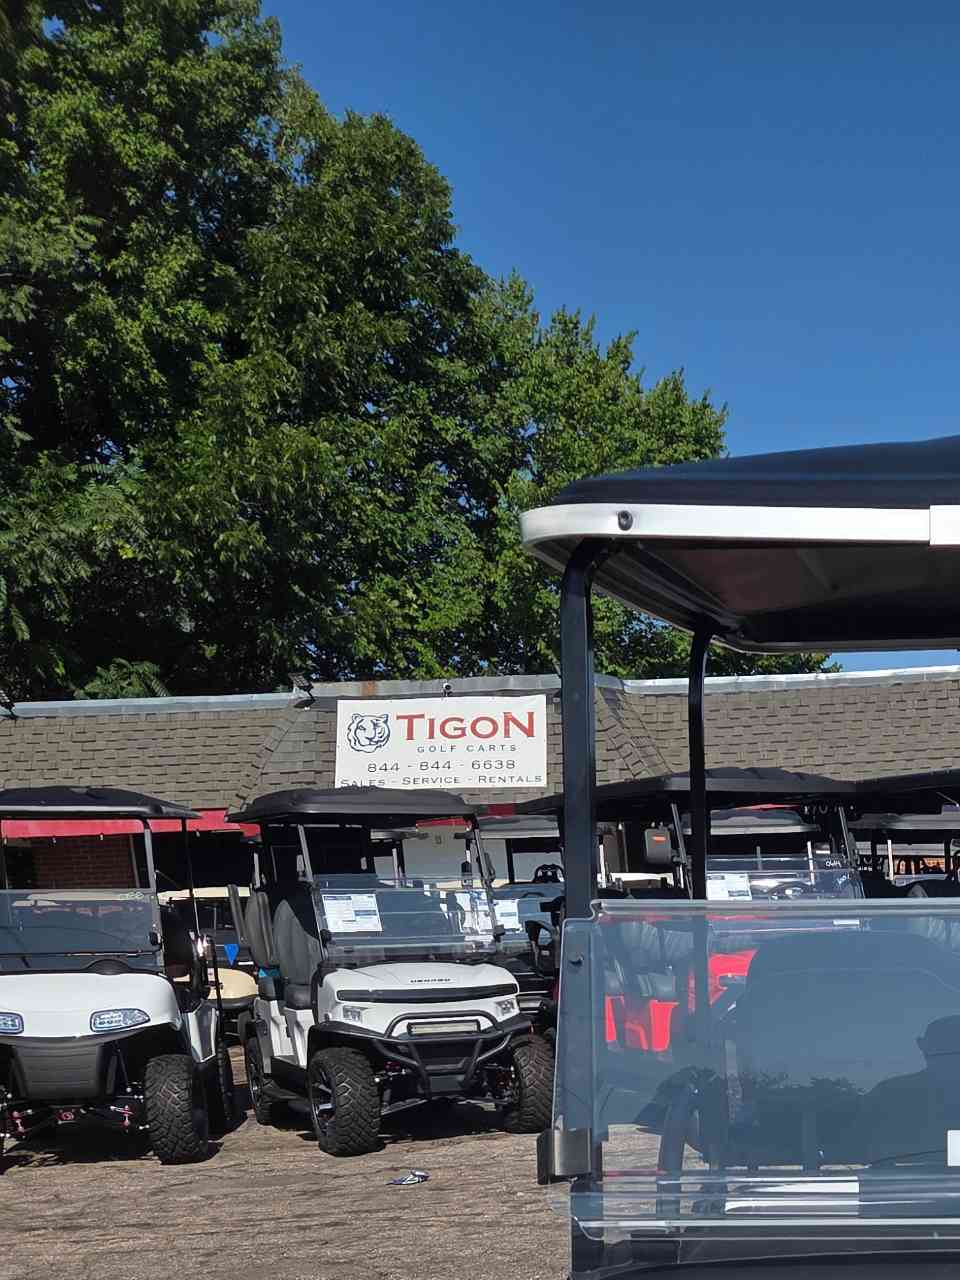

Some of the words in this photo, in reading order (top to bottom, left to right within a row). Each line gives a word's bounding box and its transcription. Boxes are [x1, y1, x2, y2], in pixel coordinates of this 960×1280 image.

[396, 711, 535, 741] TIGON
[417, 744, 457, 753] GOLF
[466, 744, 517, 752] CARTS
[402, 775, 461, 785] SERVICE
[478, 775, 542, 784] RENTALS
